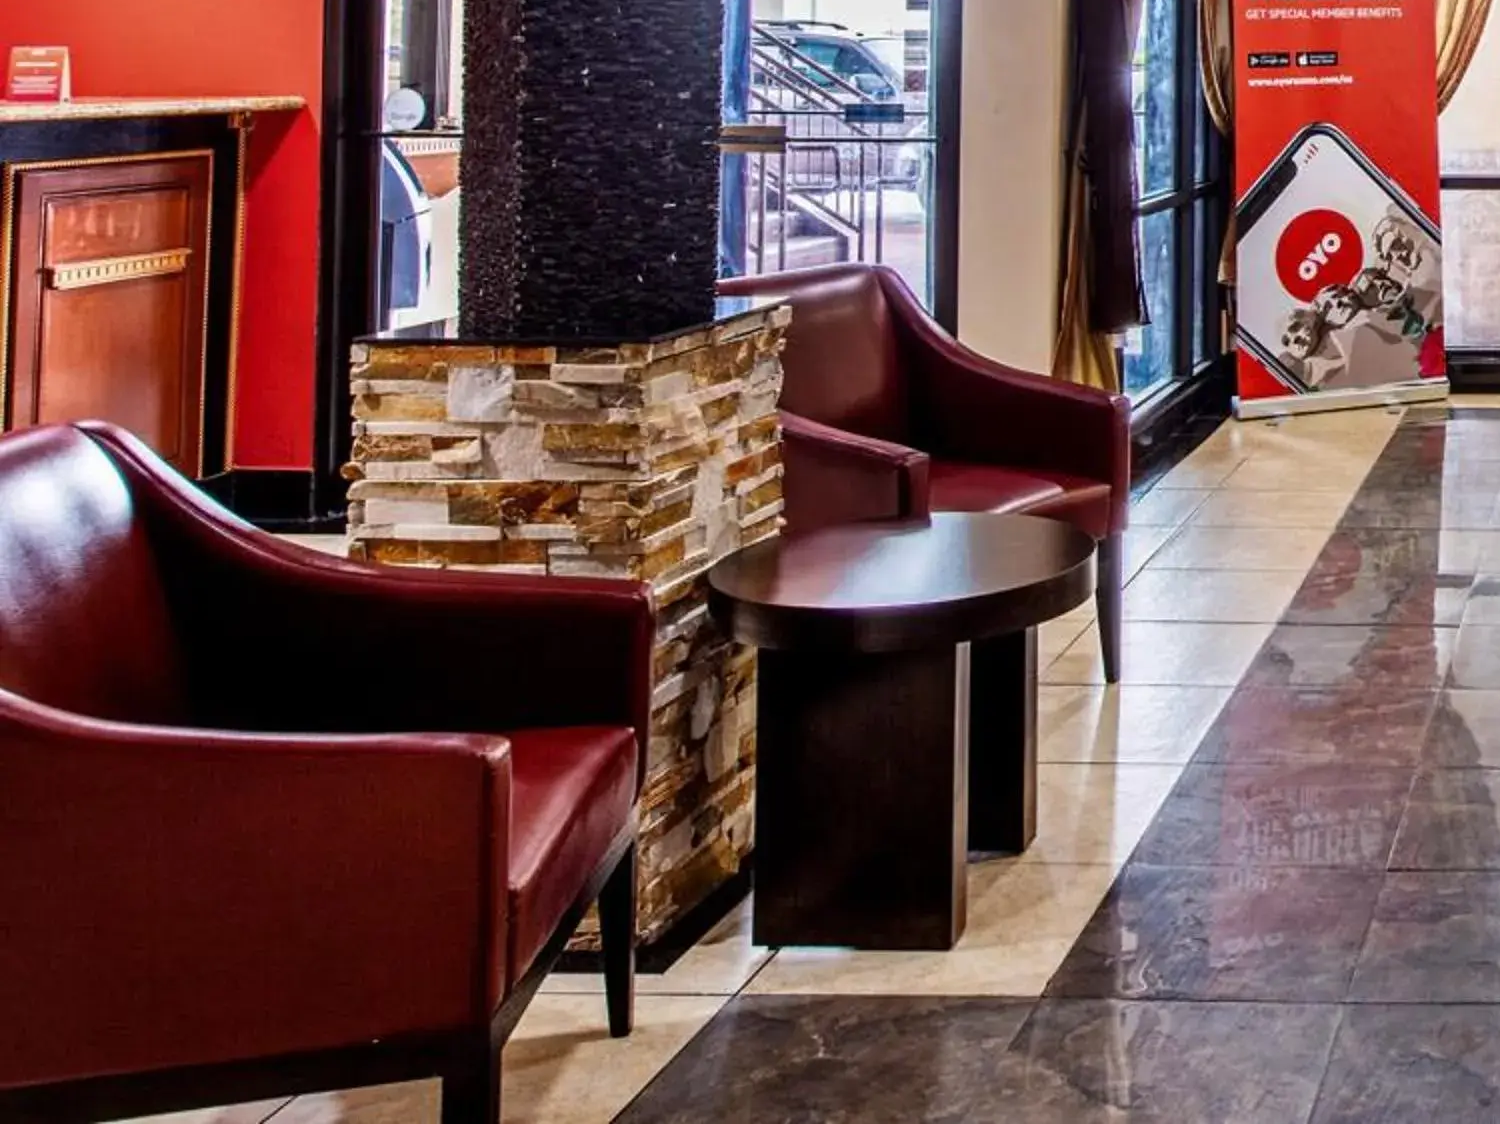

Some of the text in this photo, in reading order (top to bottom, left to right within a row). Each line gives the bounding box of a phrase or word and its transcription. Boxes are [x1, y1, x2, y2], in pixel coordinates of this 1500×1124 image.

[1245, 6, 1402, 20] GET SPECIAL MEMBER BENEFITS
[1298, 232, 1341, 281] OYO
